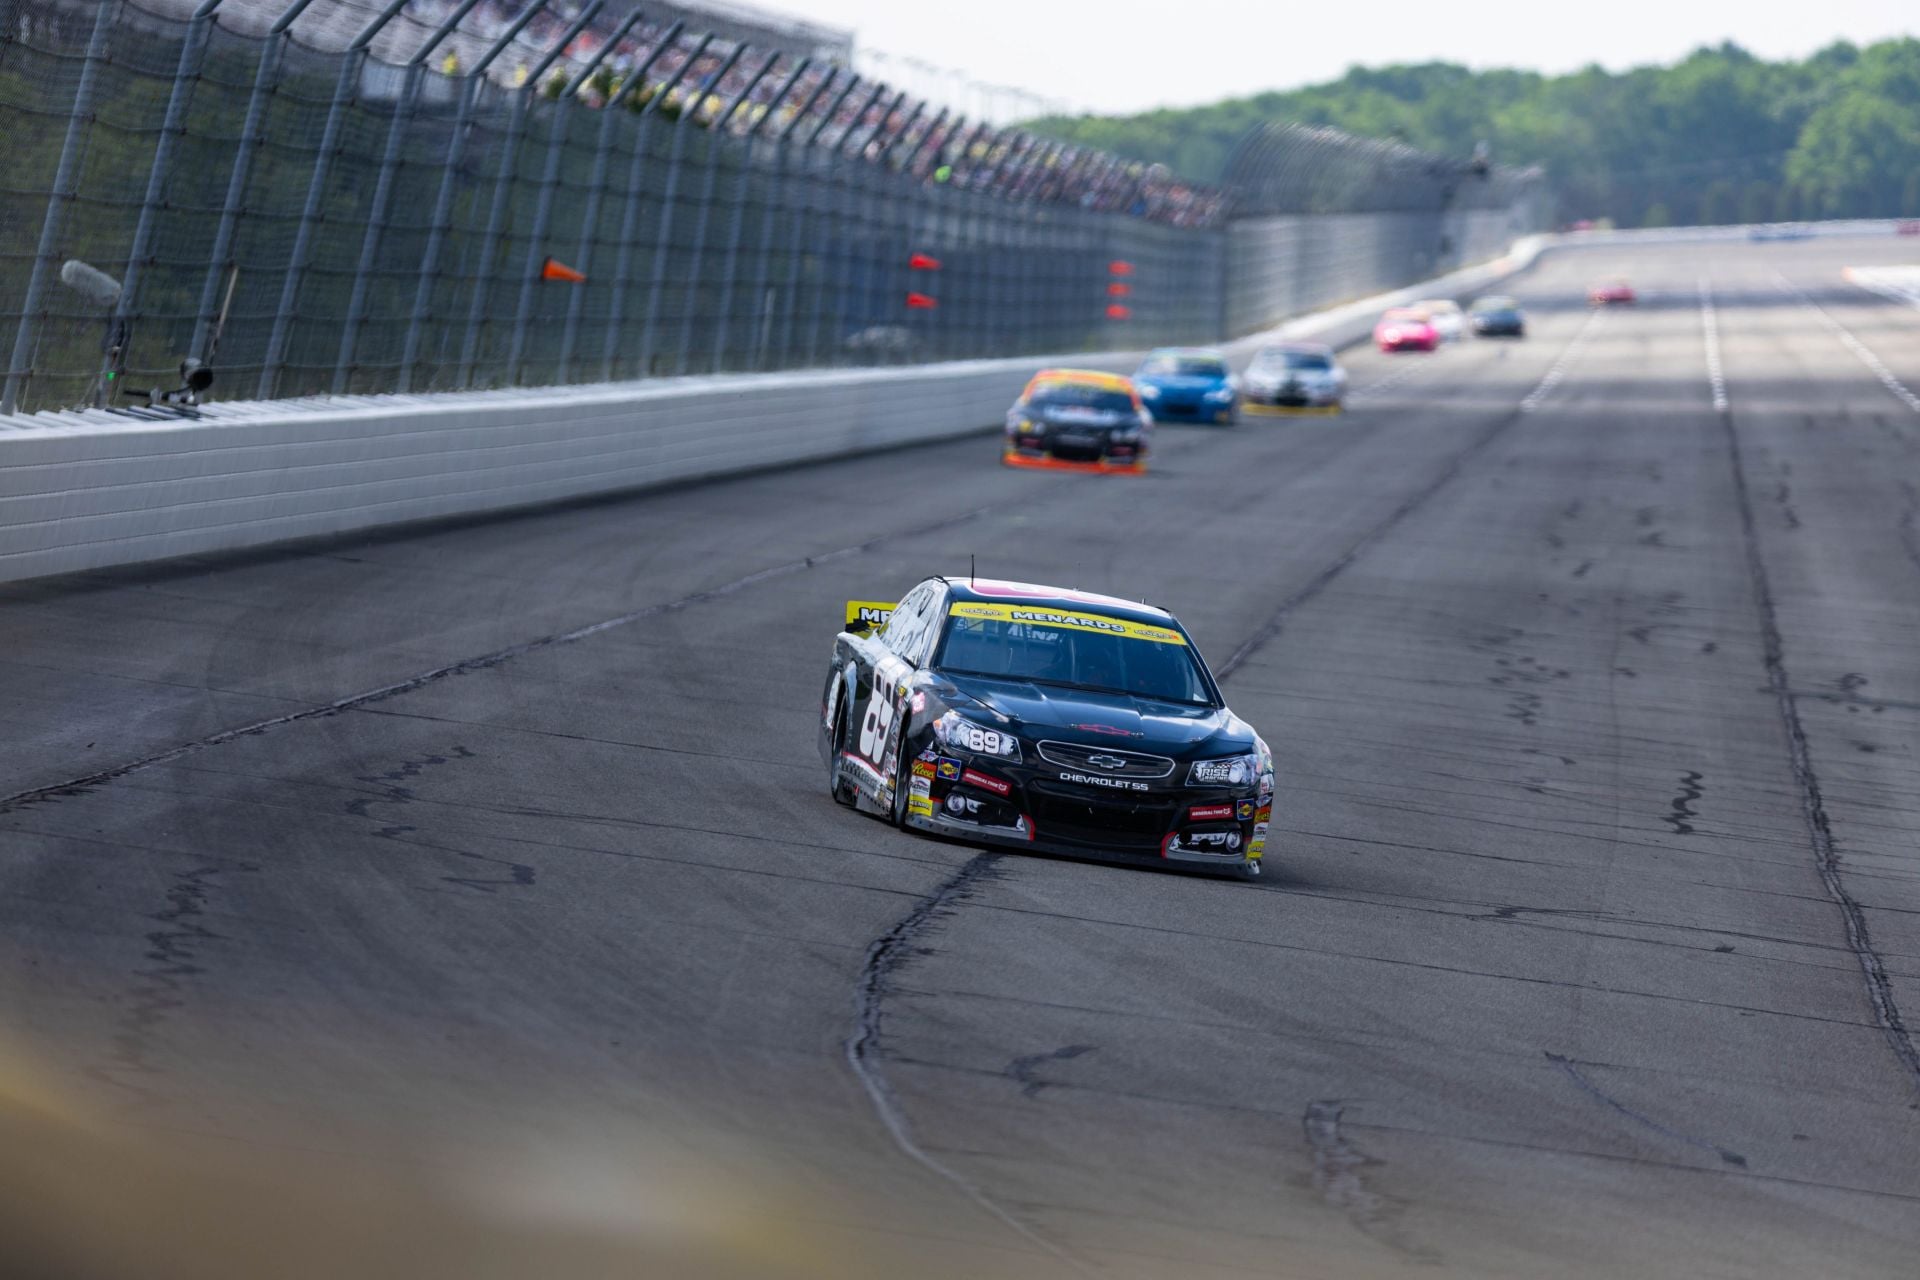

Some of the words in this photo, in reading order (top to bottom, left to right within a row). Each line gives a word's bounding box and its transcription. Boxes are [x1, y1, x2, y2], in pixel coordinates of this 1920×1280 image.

[1011, 611, 1126, 633] MENARDS
[969, 729, 1000, 754] 89
[1060, 773, 1131, 789] CHEVROLET
[1132, 783, 1149, 791] SS
[1202, 768, 1229, 777] RISE
